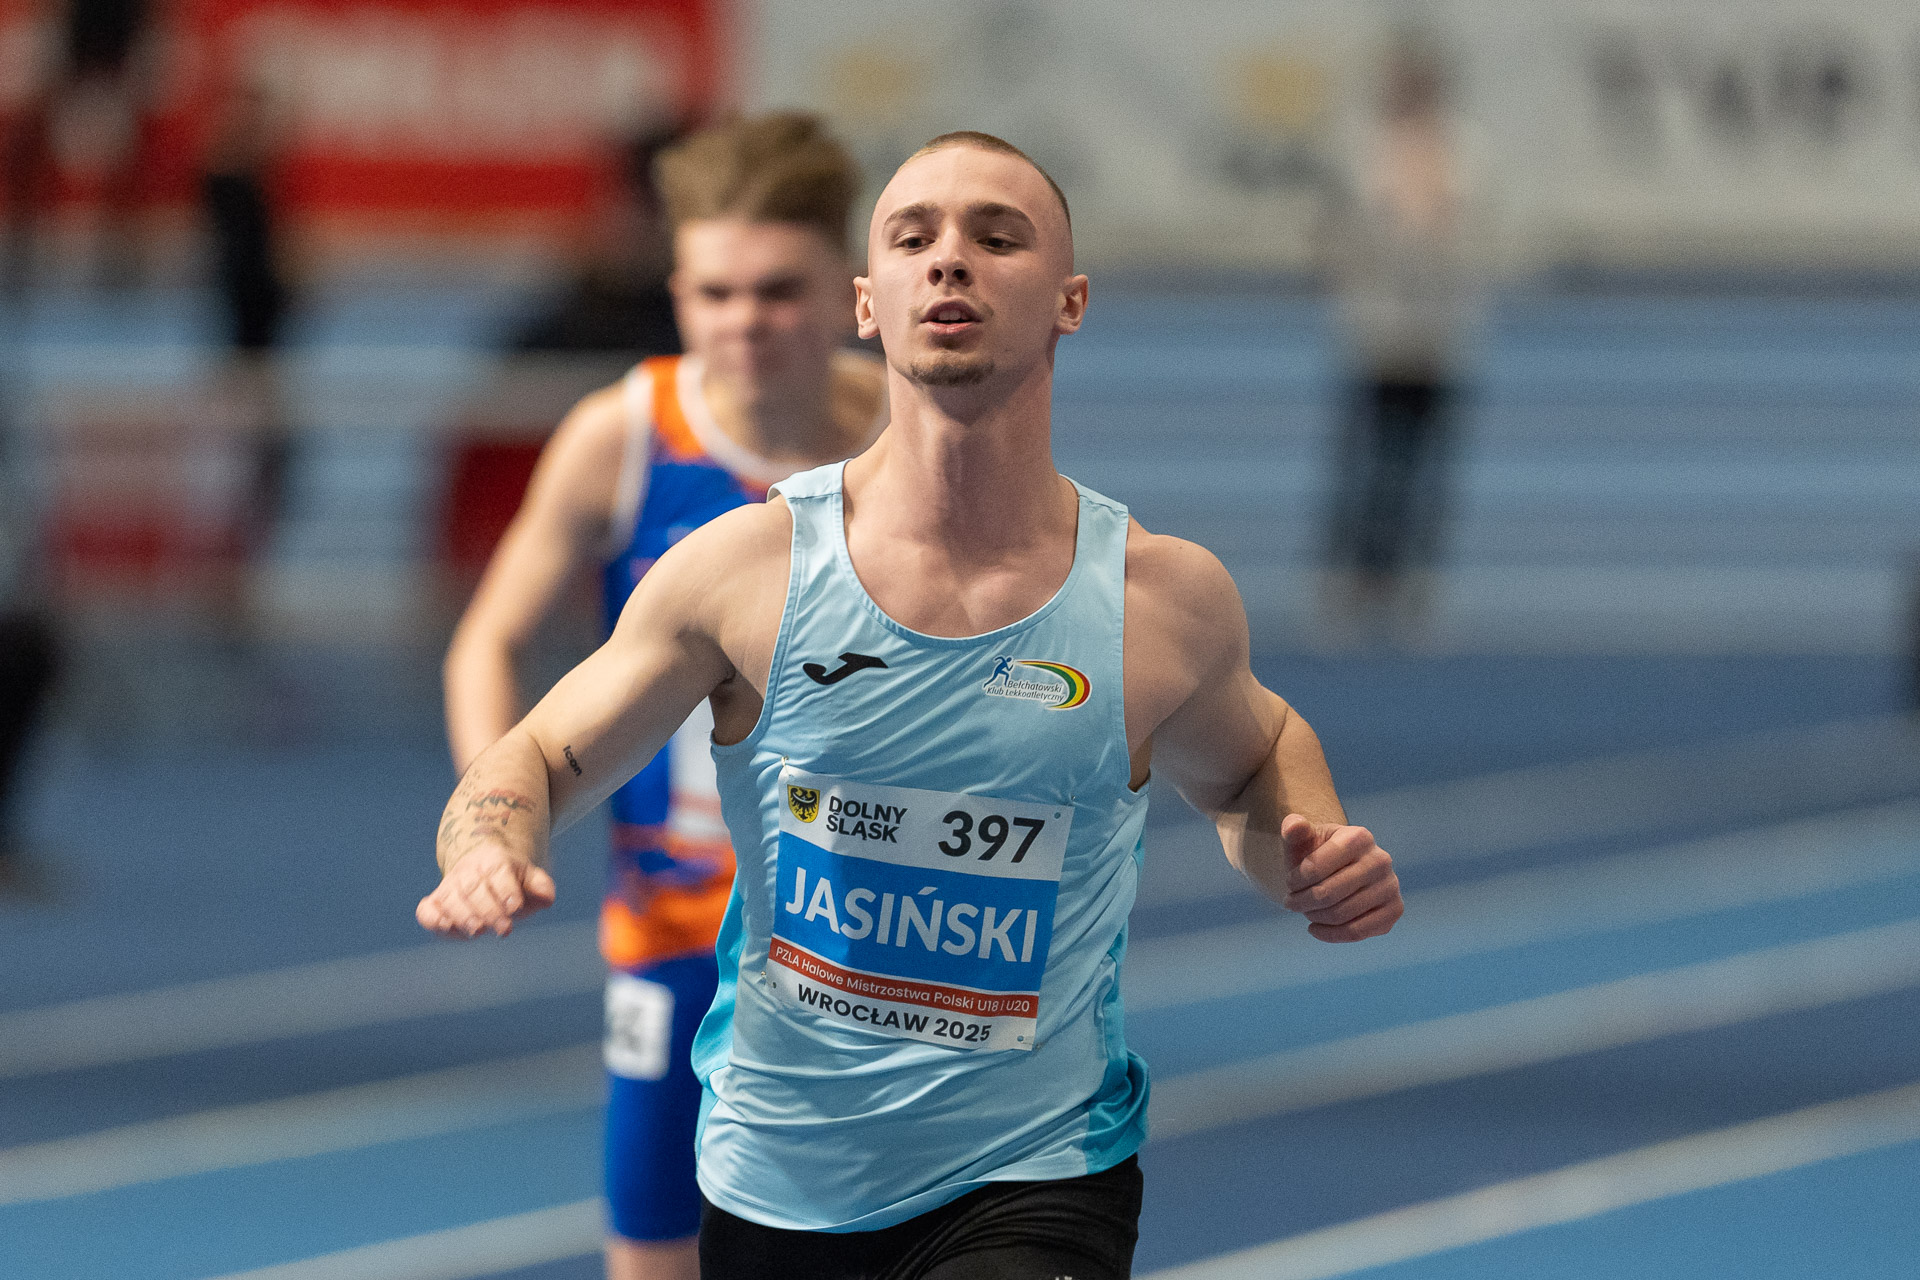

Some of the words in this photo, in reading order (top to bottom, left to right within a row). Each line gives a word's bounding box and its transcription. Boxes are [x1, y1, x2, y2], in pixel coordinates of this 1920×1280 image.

[986, 686, 1004, 695] Klub
[1005, 687, 1065, 702] Lekkoatletyczny
[826, 812, 899, 843] ŚLĄSK
[828, 795, 908, 824] DOLNY
[938, 810, 1046, 863] 397
[785, 866, 1038, 963] JASIŃSKI
[775, 946, 800, 967] PZLA
[801, 958, 844, 985] Halowe
[846, 977, 930, 1001] Mistrzostwa
[933, 991, 974, 1009] Polski
[977, 999, 999, 1012] U18
[1005, 1000, 1030, 1012] U20
[798, 983, 929, 1031] WROCŁAW
[933, 1018, 992, 1042] 2025
